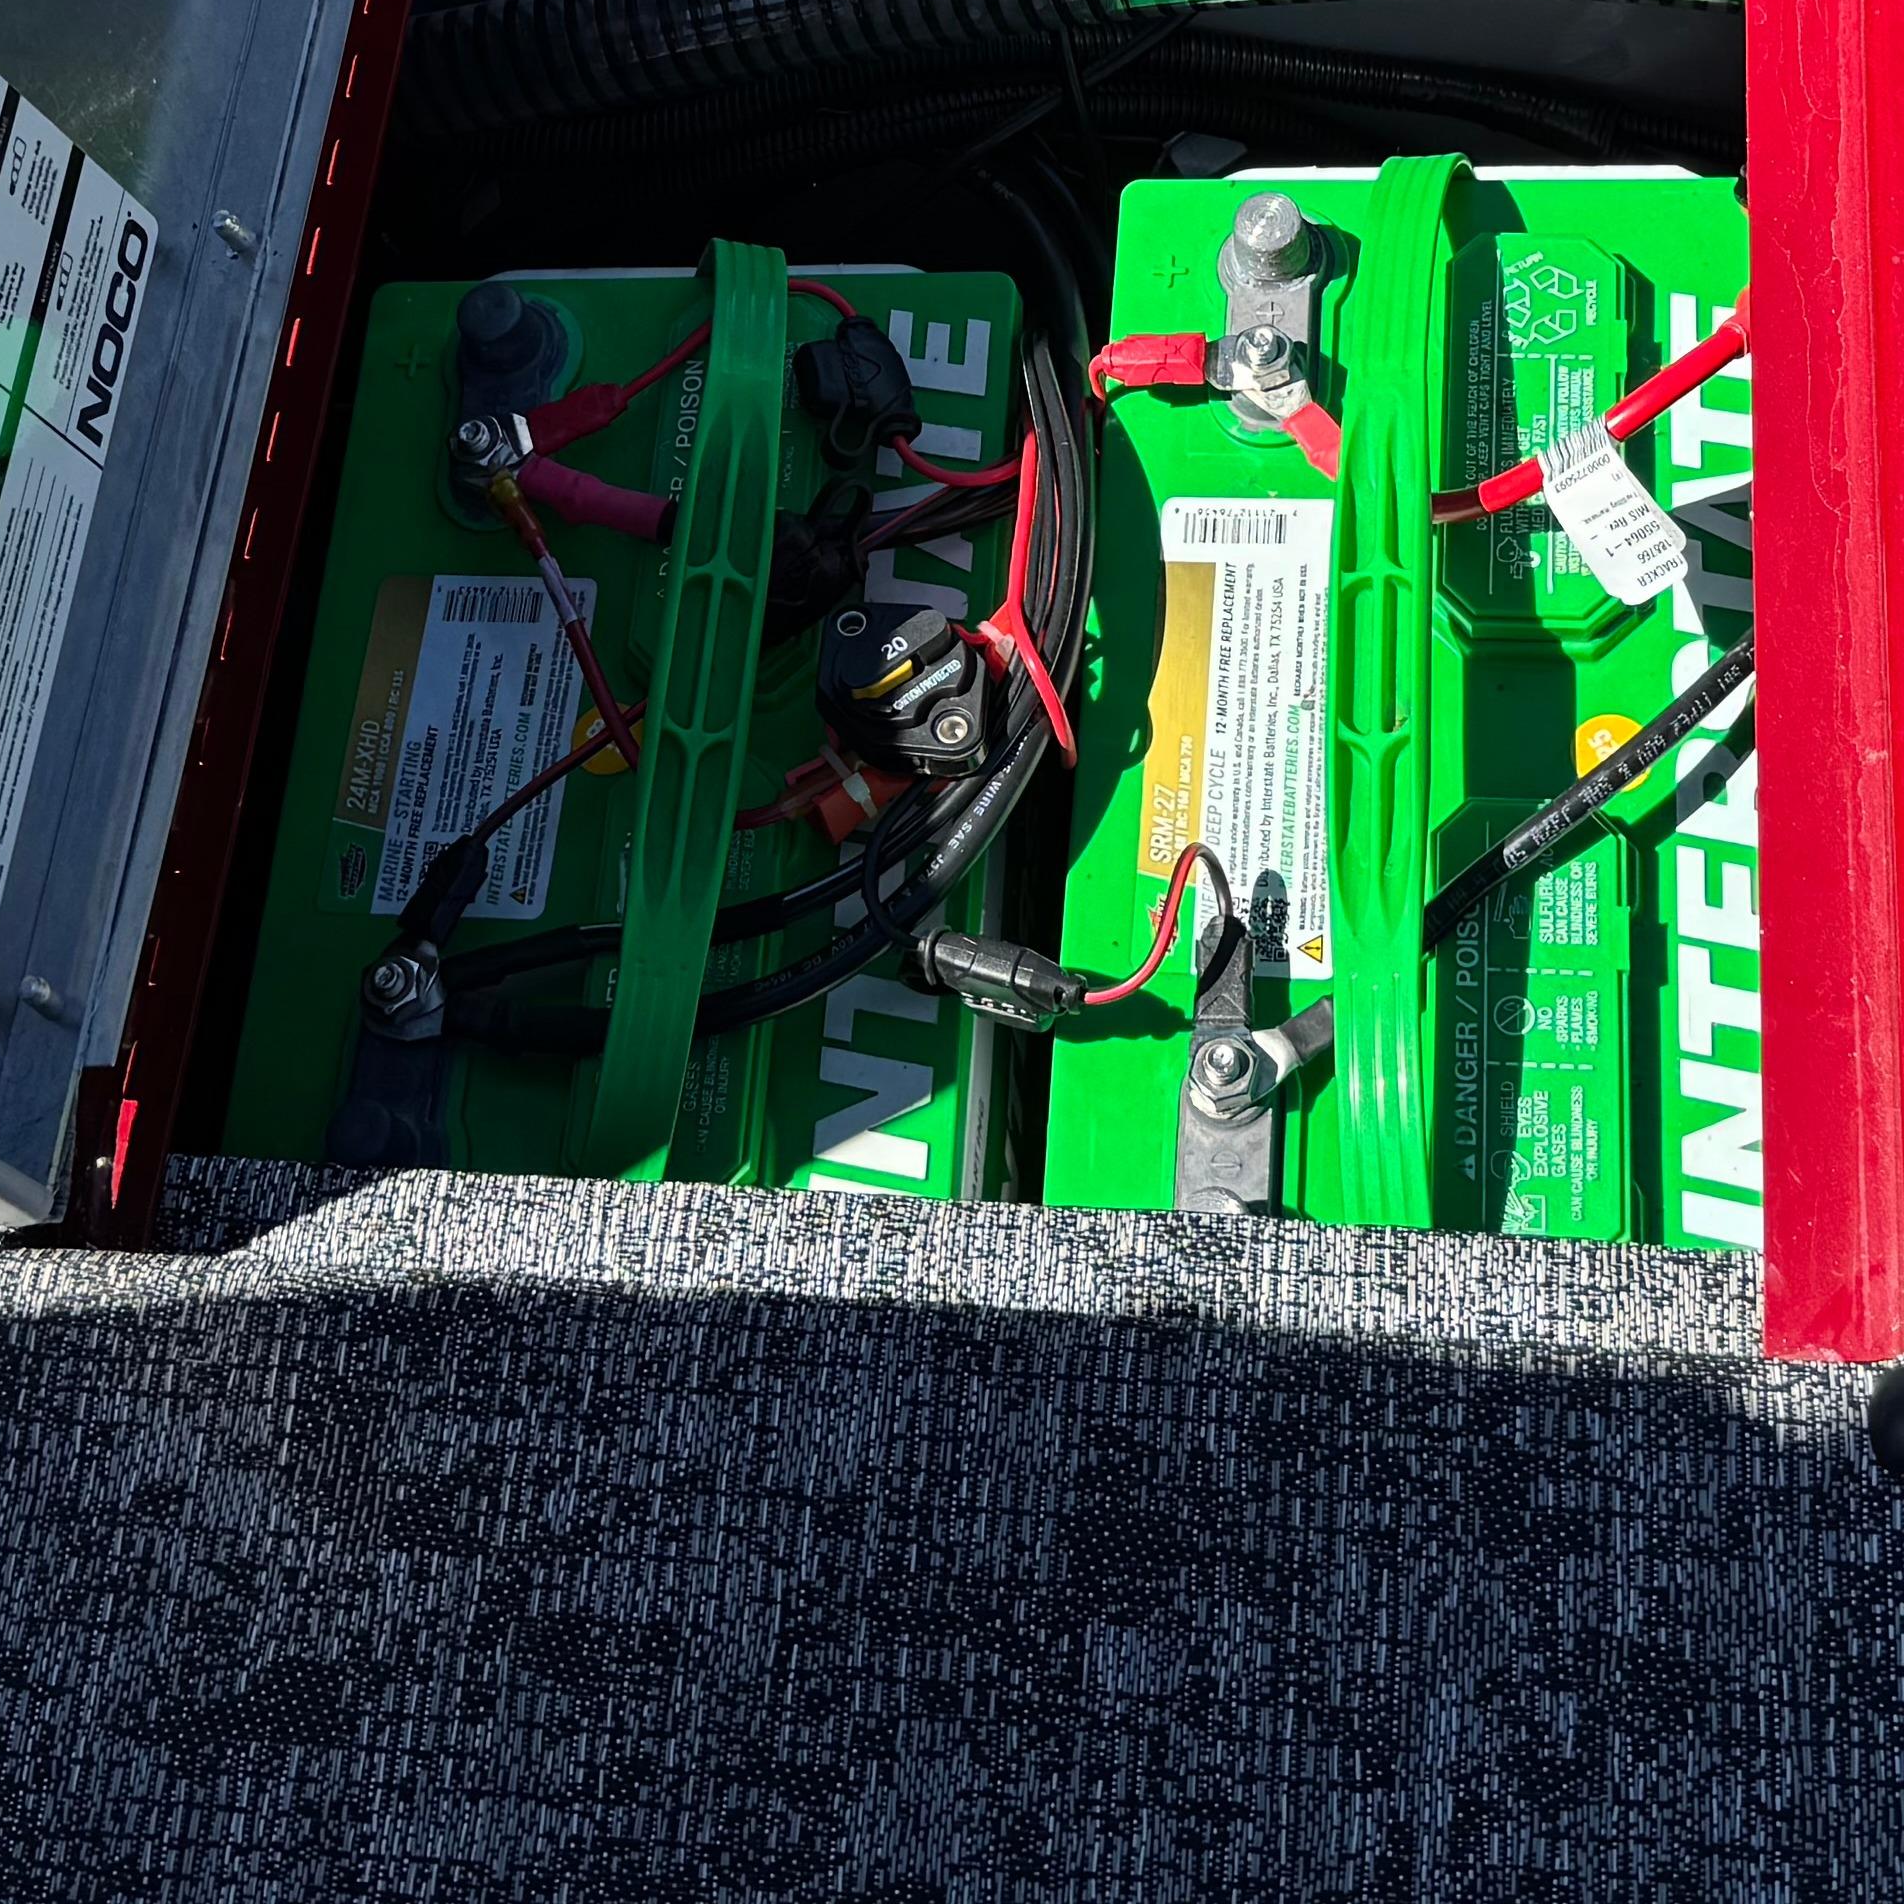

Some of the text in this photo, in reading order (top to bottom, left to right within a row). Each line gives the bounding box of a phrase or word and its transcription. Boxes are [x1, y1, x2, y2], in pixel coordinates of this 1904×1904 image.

[75, 212, 151, 448] NOCO
[674, 358, 704, 447] POISON
[1631, 504, 1650, 520] MIS
[1220, 562, 1236, 642] REPLACEMENT
[489, 653, 504, 670] Inc.
[881, 636, 908, 661] 20
[481, 671, 501, 715] Batteries,
[1215, 675, 1230, 734] 12-MONTH
[471, 717, 491, 763] Interstate
[1263, 710, 1278, 757] Batteries,
[343, 720, 383, 810] 24M-XHD
[482, 750, 498, 780] 75254
[1208, 748, 1225, 799] CYCLE
[375, 740, 423, 901] MARINE STARTING
[394, 724, 441, 902] 12-MONTH FREE REPLACEMENT
[459, 779, 481, 832] Distributed
[1148, 783, 1176, 863] SRM-27
[1206, 804, 1223, 845] DEEP
[1256, 829, 1271, 886] Distributed
[1537, 1007, 1553, 1030] NO
[1454, 1020, 1478, 1145] DANGER
[1500, 1081, 1515, 1136] SHIELD
[1517, 1096, 1533, 1137] EYES
[1533, 1089, 1549, 1176] EXPLOSIVE
[1551, 1123, 1567, 1176] GASES
